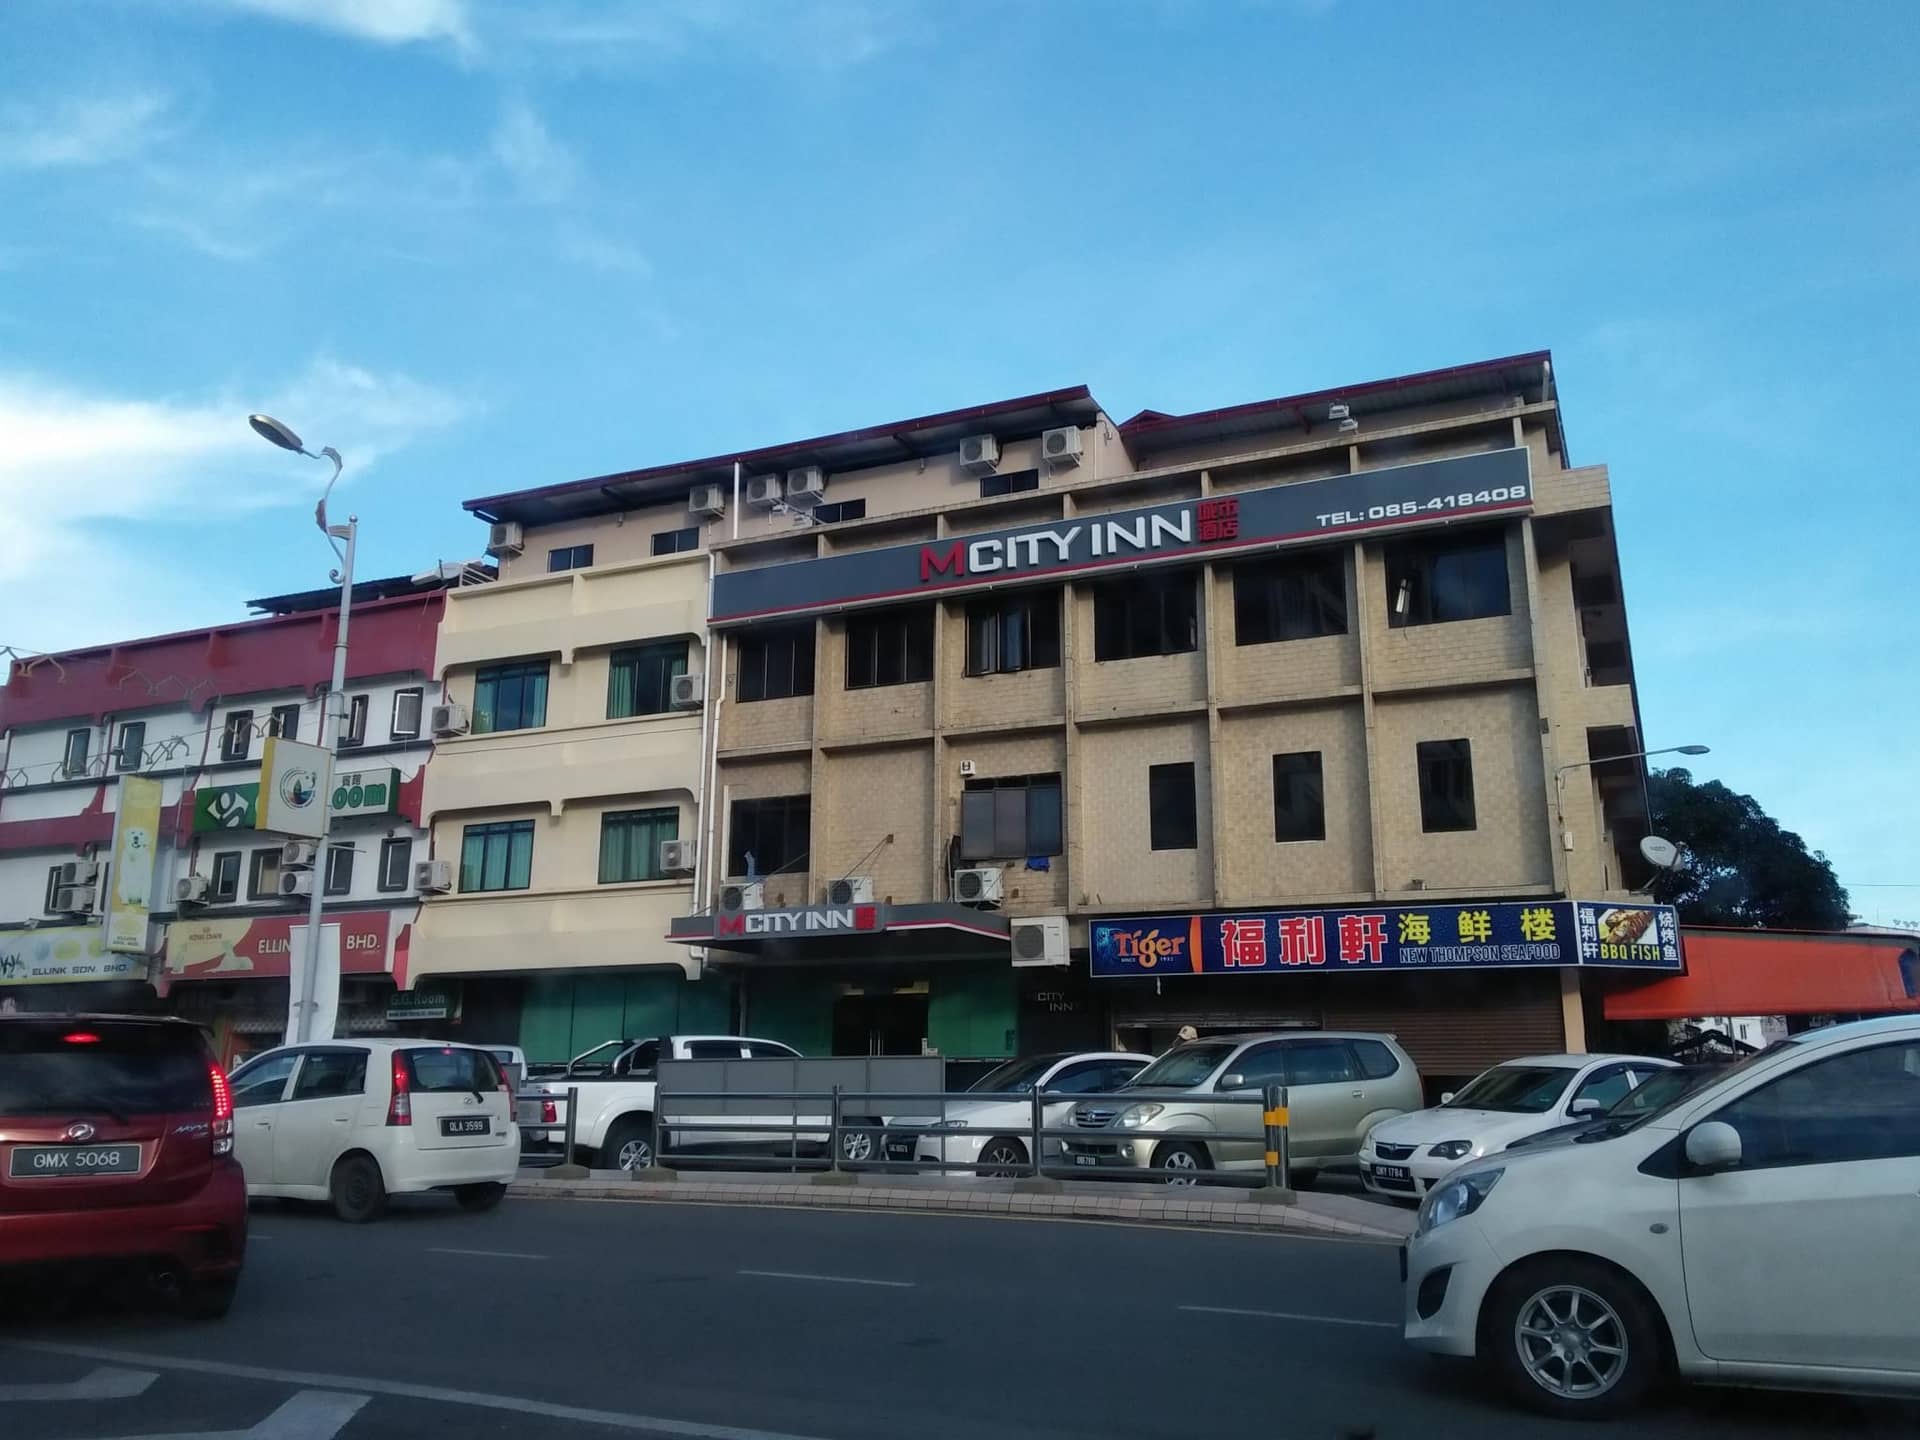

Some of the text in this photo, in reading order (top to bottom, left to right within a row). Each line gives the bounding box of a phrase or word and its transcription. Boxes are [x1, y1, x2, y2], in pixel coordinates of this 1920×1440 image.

[1316, 485, 1526, 527] TEL: 085-418408
[1091, 509, 1192, 556] INN
[332, 783, 387, 810] oom
[805, 909, 854, 930] INN
[258, 934, 380, 953] ELLIN BHD.
[1113, 929, 1186, 968] Tiger
[1400, 943, 1560, 963] NEW THOMPSON SEAFOOD
[1601, 943, 1660, 960] BBQ FISH
[32, 967, 67, 976] ELLINK
[75, 1151, 120, 1167] 5068
